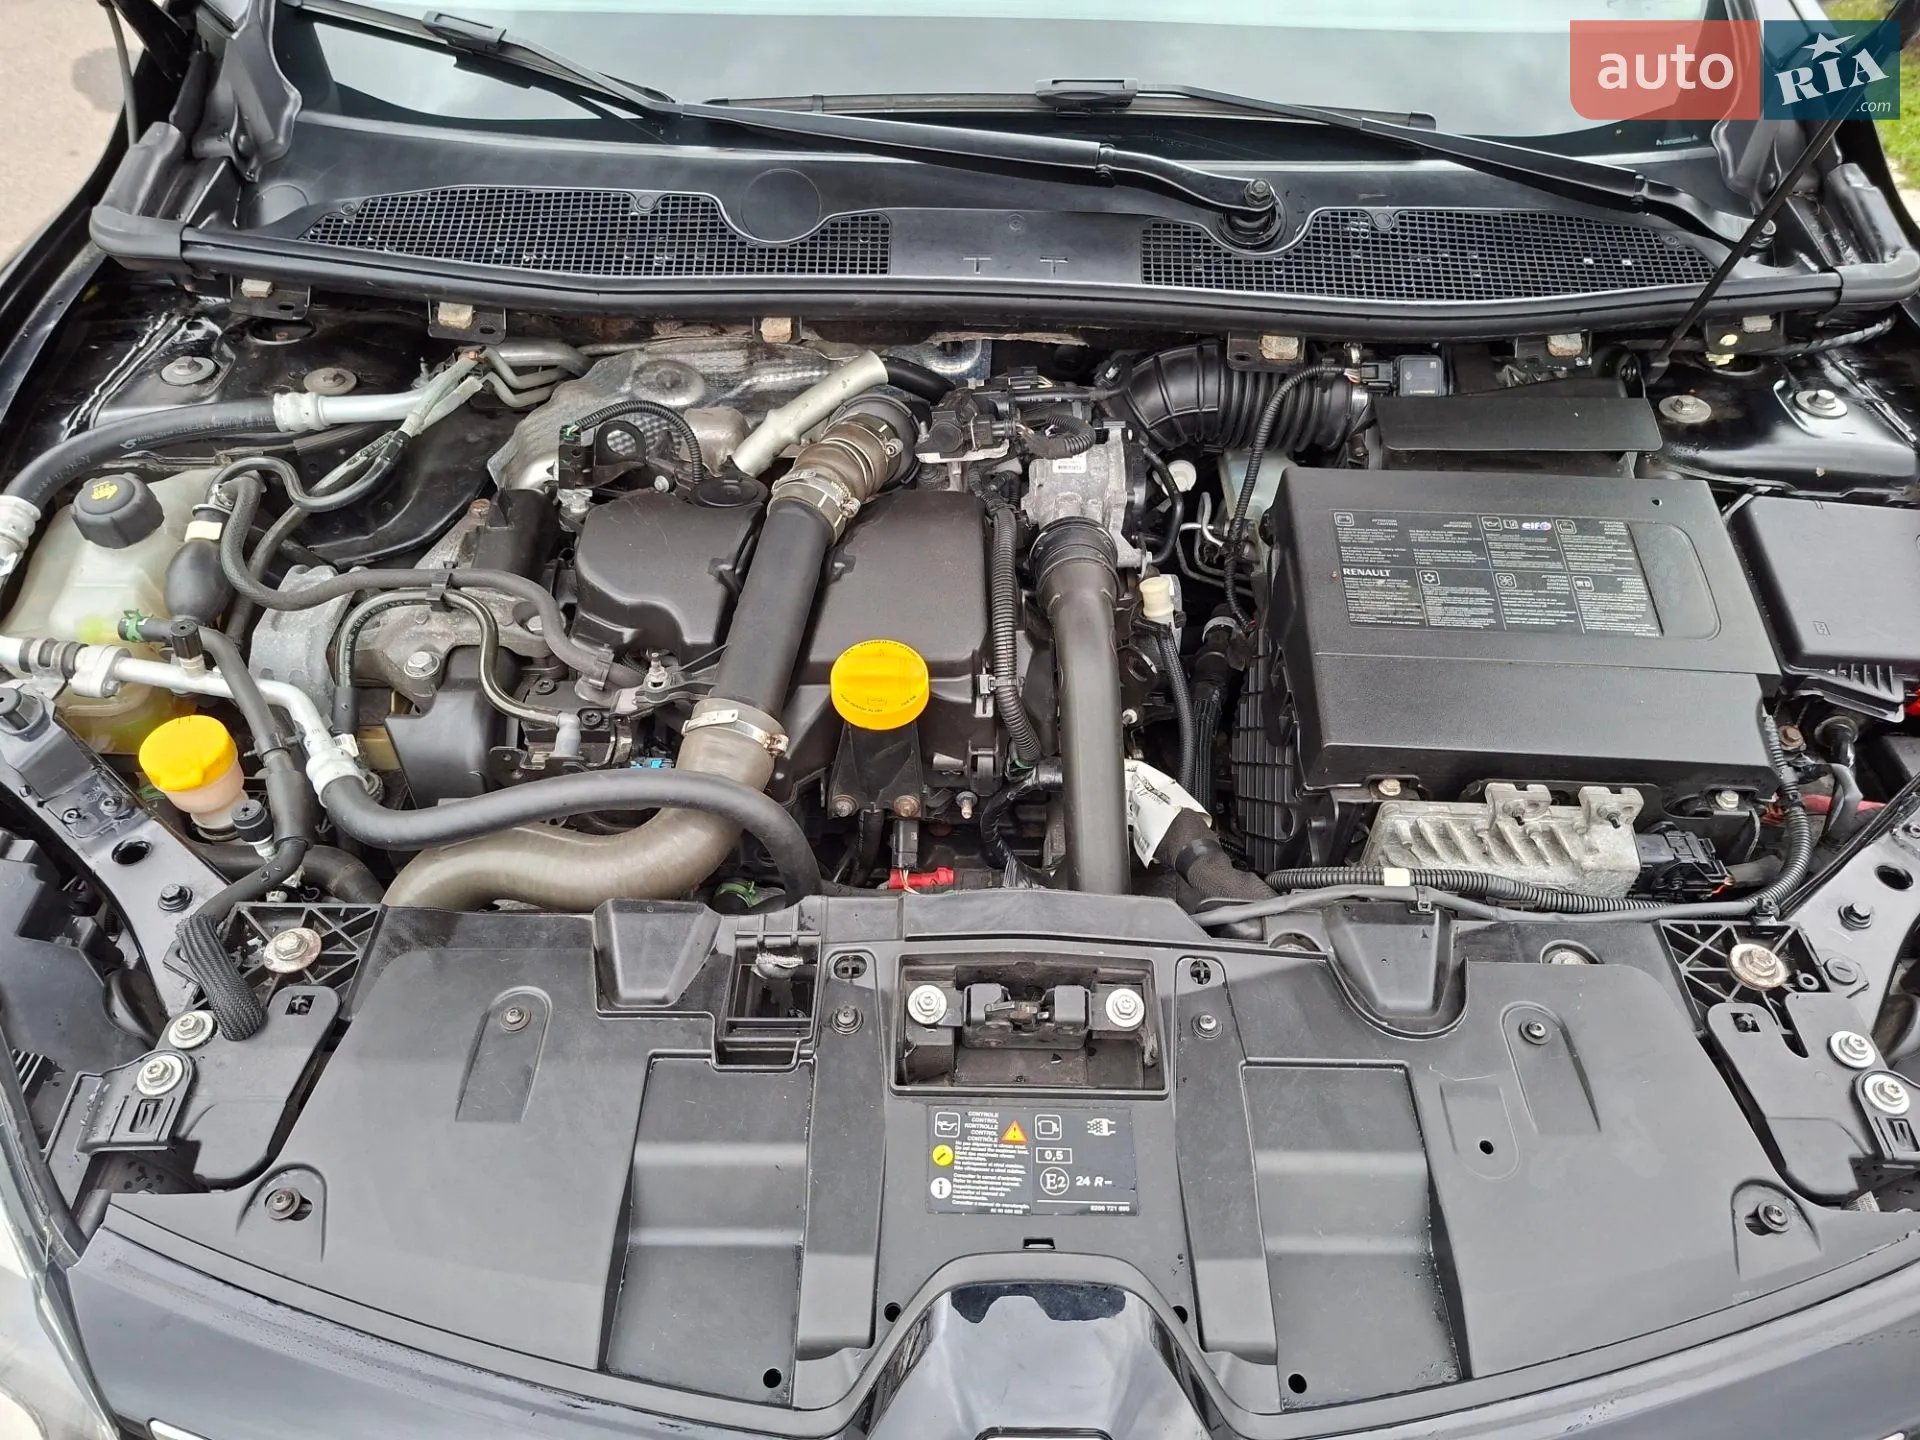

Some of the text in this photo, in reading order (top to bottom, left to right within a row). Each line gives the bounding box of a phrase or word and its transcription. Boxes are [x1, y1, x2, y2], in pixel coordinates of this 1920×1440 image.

[1342, 567, 1391, 577] RENAULT
[1044, 1150, 1063, 1161] 0,5
[1045, 1173, 1066, 1189] E2
[1075, 1176, 1090, 1186] 24
